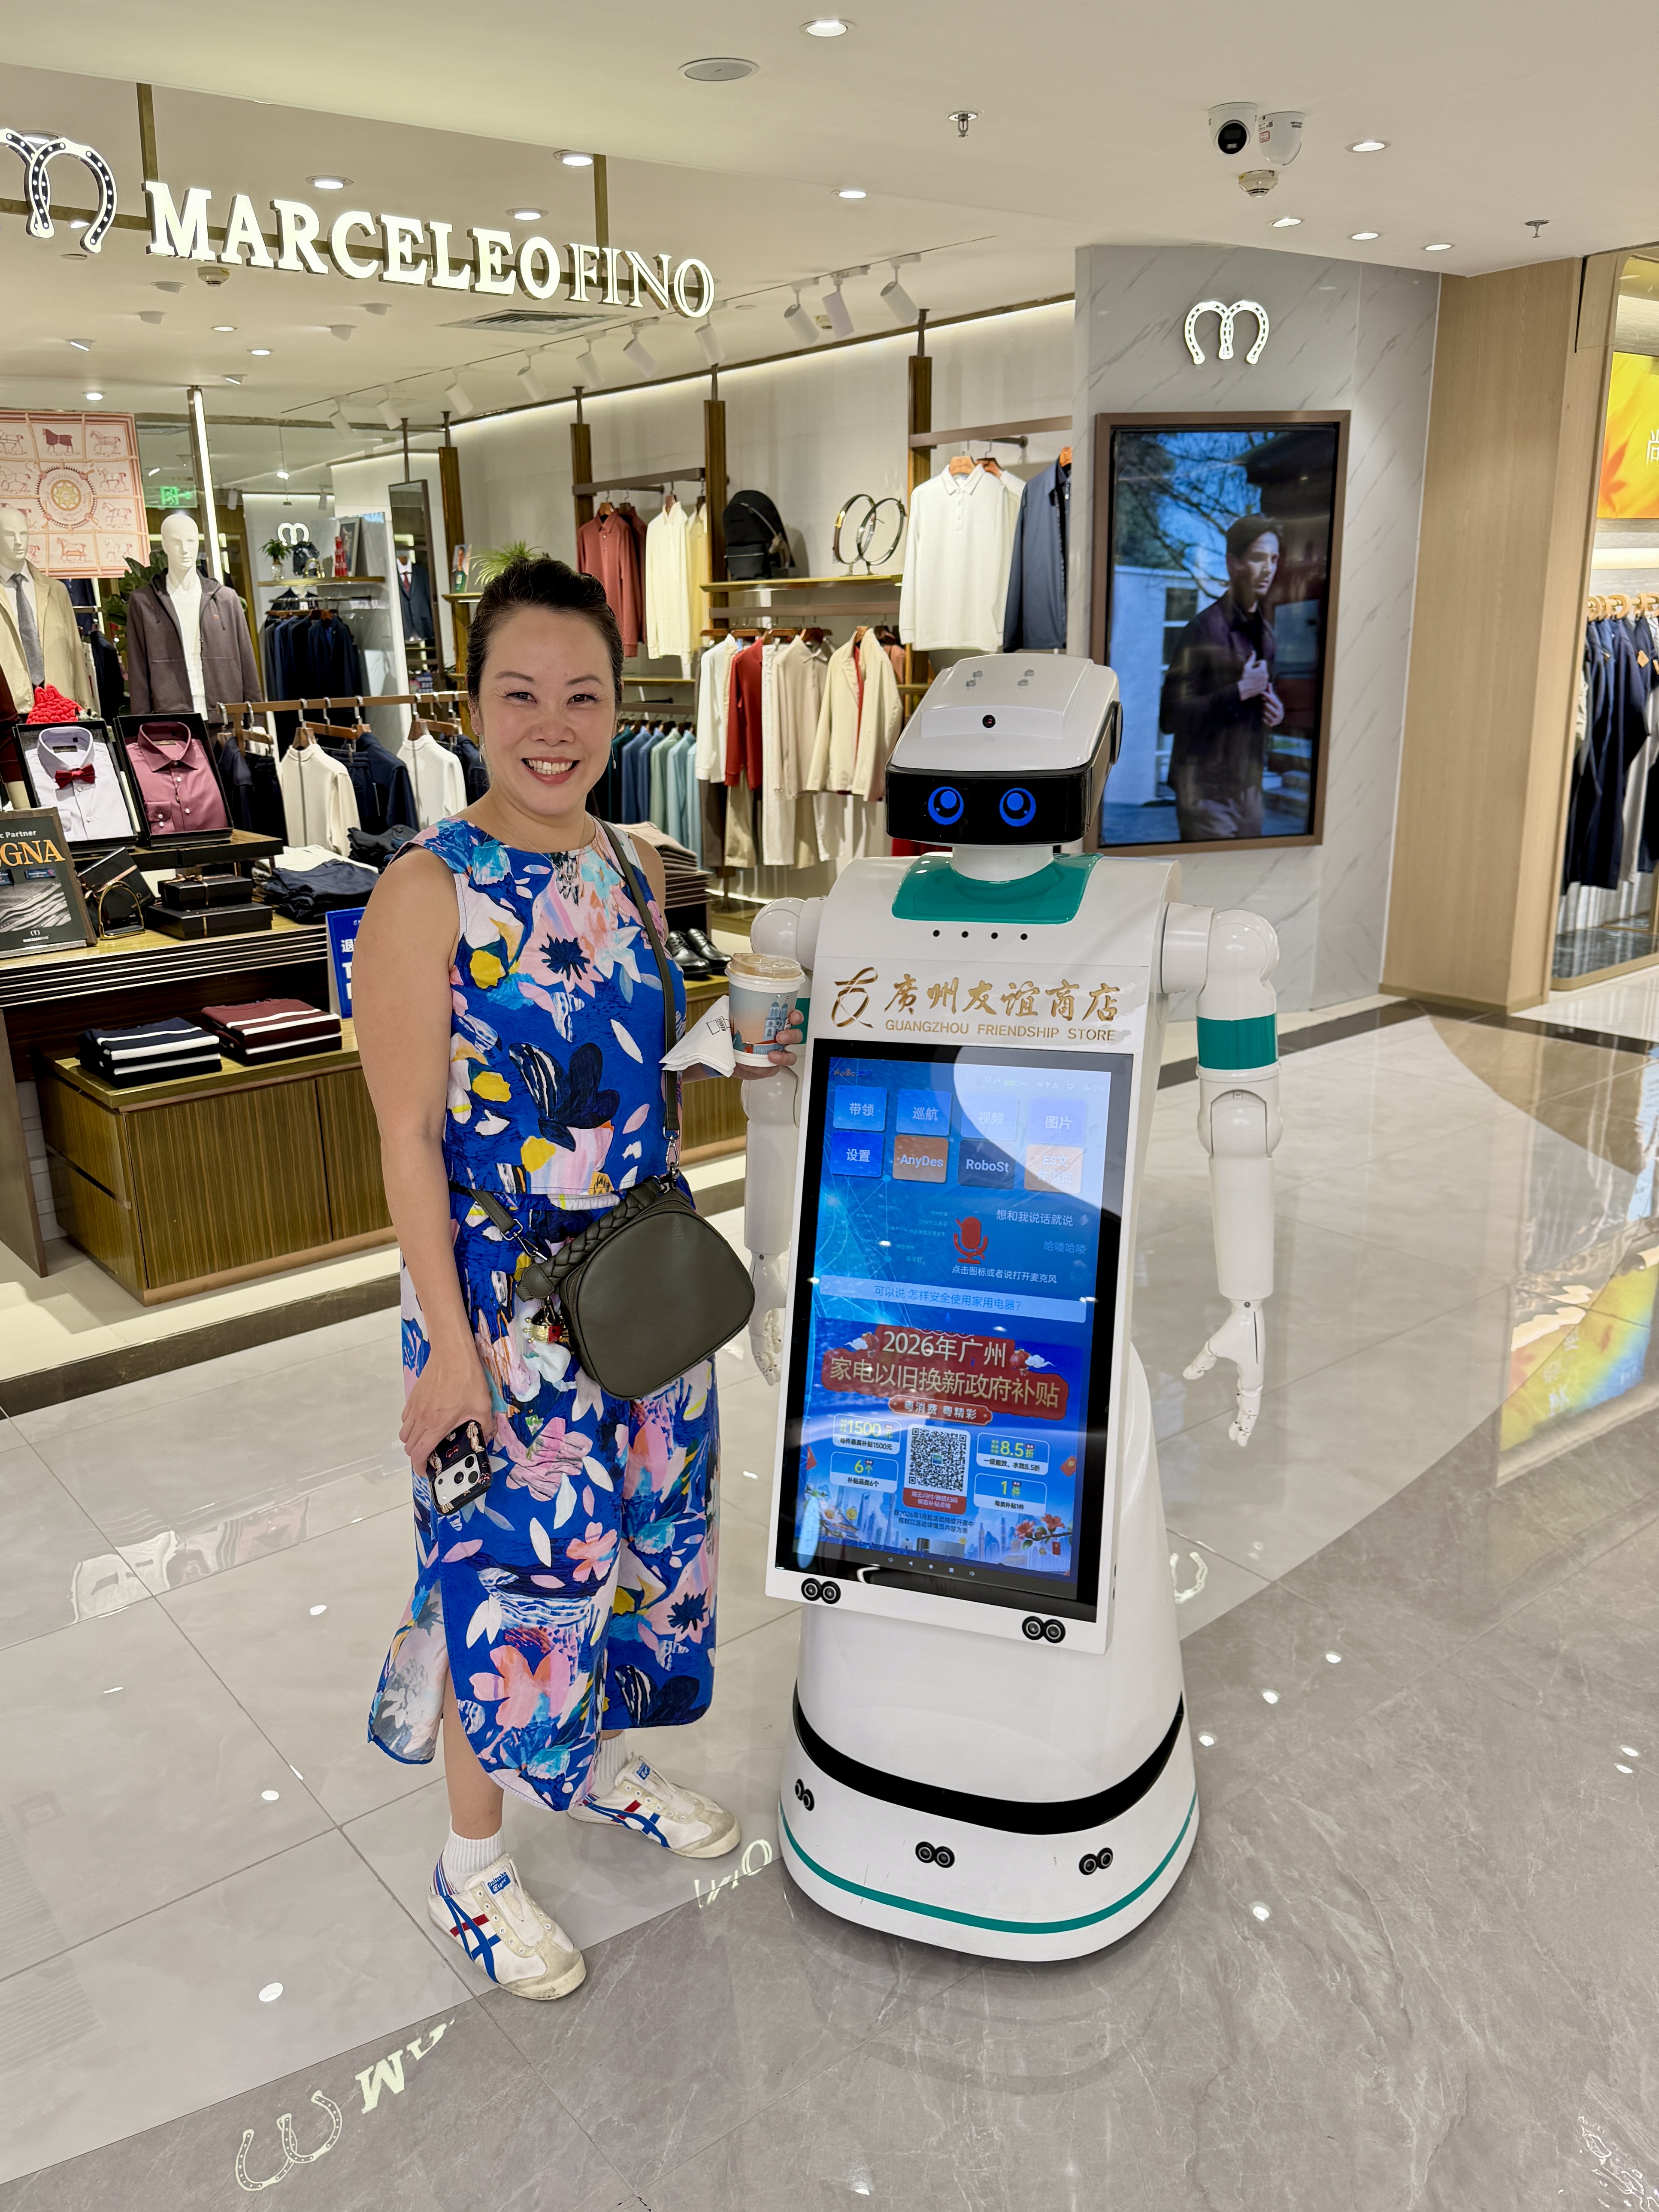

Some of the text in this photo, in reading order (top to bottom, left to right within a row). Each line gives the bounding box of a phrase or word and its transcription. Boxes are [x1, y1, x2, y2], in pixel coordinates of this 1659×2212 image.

[0, 839, 66, 867] GNA
[885, 1019, 1116, 1042] GUANGZHOU FRIENDSHIP STORE
[849, 1102, 875, 1117] 带领
[912, 1106, 938, 1121] 巡航
[978, 1110, 1005, 1126] 视频
[1045, 1115, 1072, 1130] 图片
[846, 1148, 871, 1162] 设置
[899, 1154, 944, 1168] AnyDes
[1042, 1154, 1069, 1167] ES文
[966, 1159, 1009, 1173] RoboSt
[996, 1209, 1073, 1227] 想和我说话就说
[1044, 1241, 1086, 1254] 哈喽哈喽
[951, 1265, 1057, 1284] 点击图标或者说打开麦克风
[874, 1285, 905, 1299] 可以说
[882, 1330, 1007, 1368] 2026年广州
[830, 1357, 1061, 1409] 家电以旧换新政府补贴
